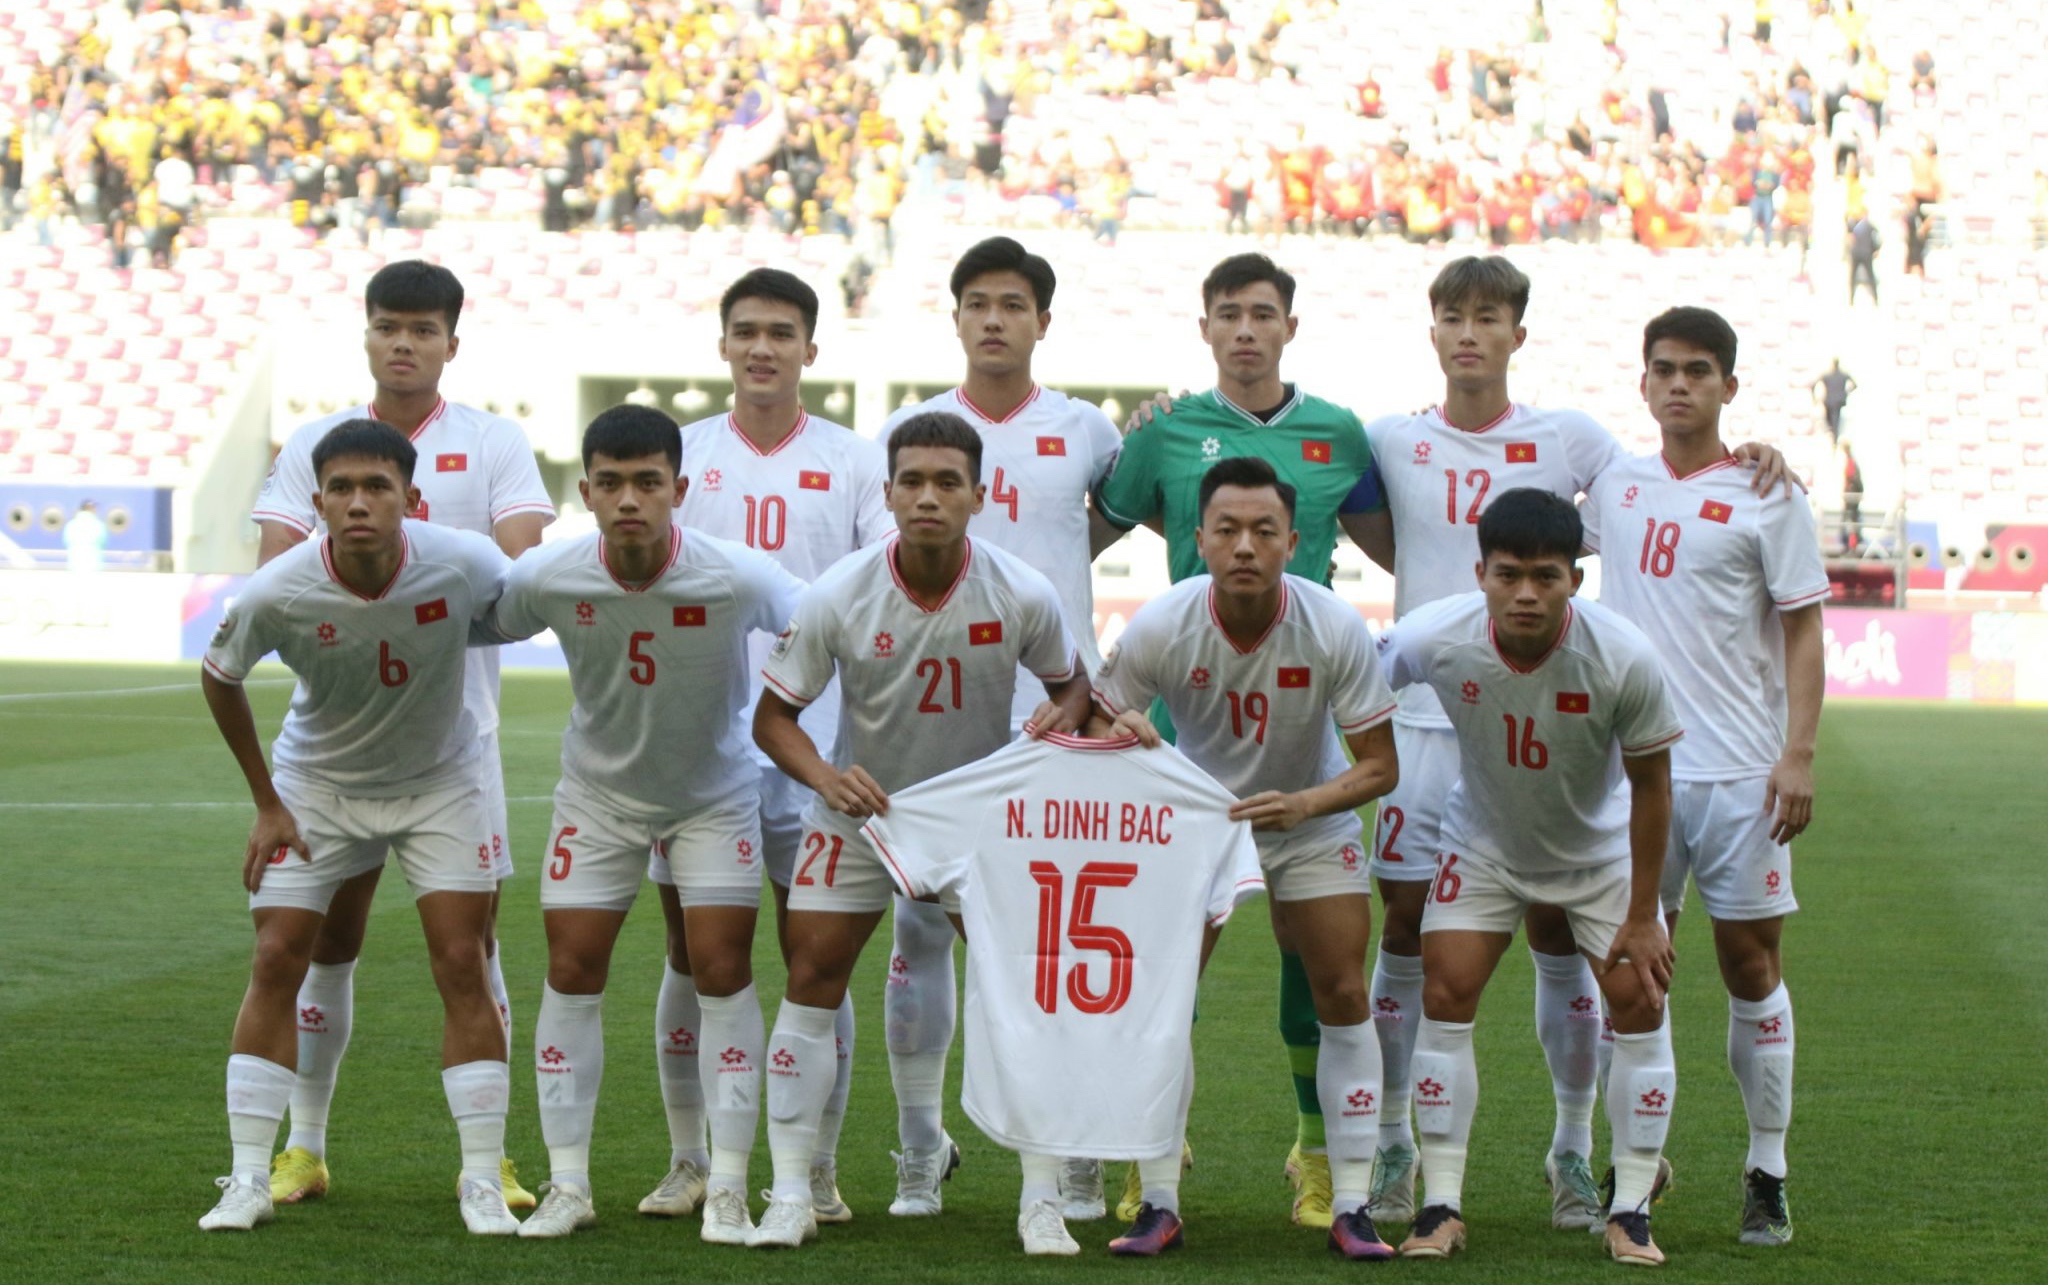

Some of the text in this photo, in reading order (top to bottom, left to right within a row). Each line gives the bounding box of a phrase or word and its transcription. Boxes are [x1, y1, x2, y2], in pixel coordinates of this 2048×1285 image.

[744, 494, 787, 552] 10
[991, 466, 1018, 523] 4
[1444, 468, 1491, 525] 12
[1639, 517, 1681, 579] 18
[379, 640, 409, 687] 6
[628, 631, 657, 686] 5
[915, 657, 962, 714] 21
[1226, 690, 1269, 745] 19
[1502, 712, 1549, 770] 16
[1006, 798, 1173, 846] N. DINH BAC
[548, 826, 578, 882] 5
[795, 831, 845, 889] 21
[1028, 860, 1139, 1015] 15
